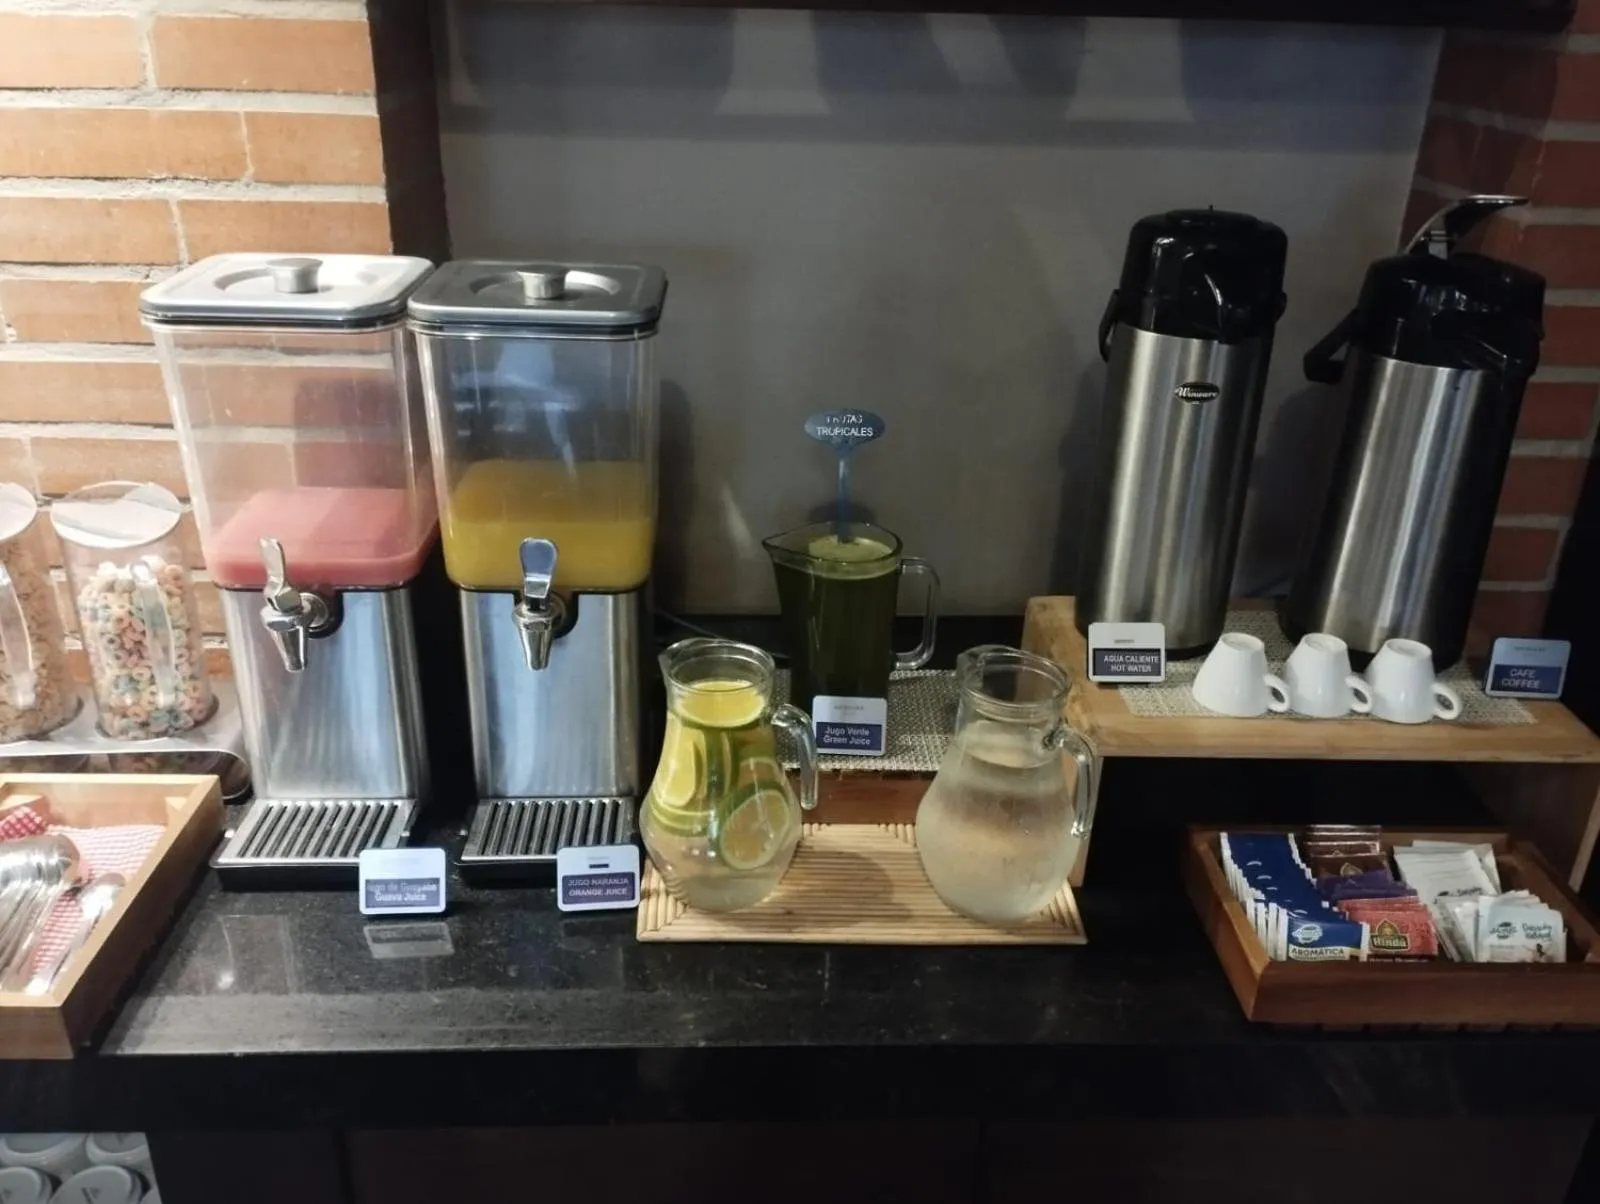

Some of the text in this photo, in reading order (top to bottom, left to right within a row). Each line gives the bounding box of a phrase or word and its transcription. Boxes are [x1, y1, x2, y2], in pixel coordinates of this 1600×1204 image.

[816, 426, 873, 437] TROPICALES
[1103, 655, 1160, 663] AGUA CALIENTE
[1110, 665, 1152, 673] HOT WATER
[825, 726, 870, 736] Jugo Verde
[823, 735, 848, 744] Green
